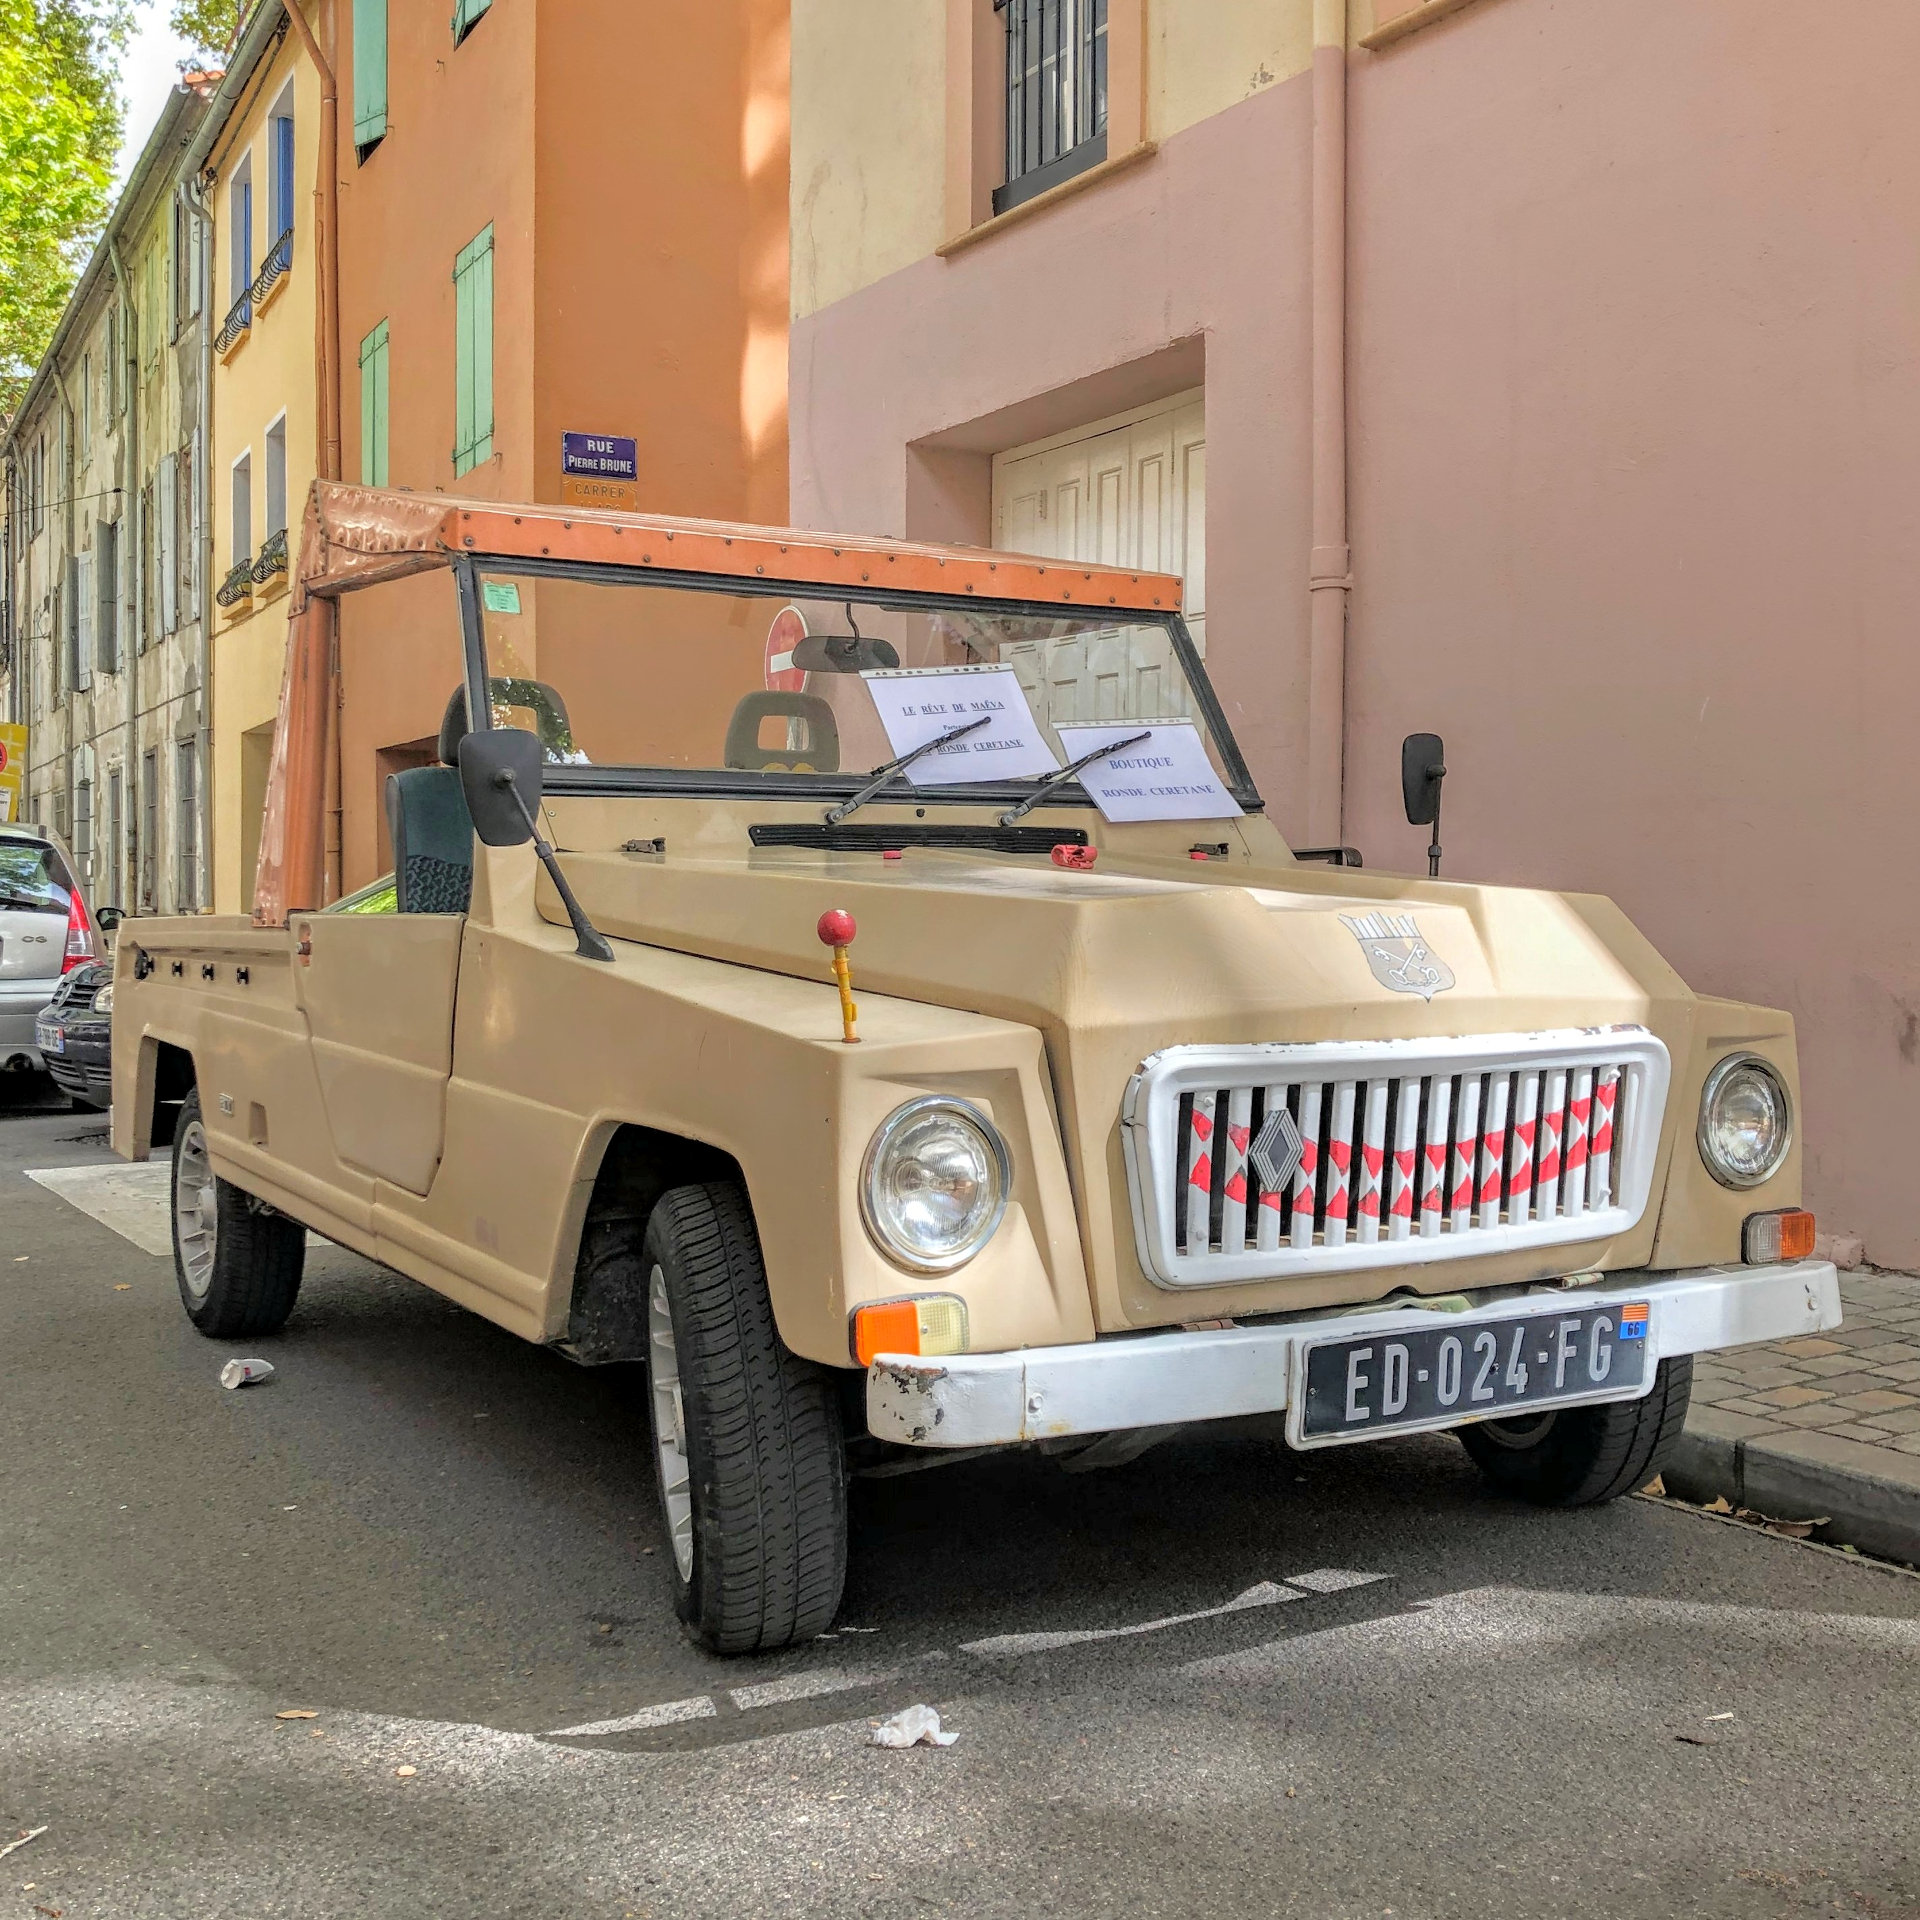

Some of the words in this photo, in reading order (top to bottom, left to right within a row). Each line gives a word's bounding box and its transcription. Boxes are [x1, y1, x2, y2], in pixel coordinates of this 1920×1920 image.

[587, 439, 614, 454] RUE
[568, 454, 599, 470] PIERRE
[600, 457, 632, 473] BRUNE
[575, 483, 625, 499] CARRER
[902, 706, 917, 716] LE
[952, 703, 967, 712] DE
[937, 743, 970, 754] RONDE
[1109, 757, 1173, 770] BOUTIQUE
[1101, 787, 1146, 798] RONDE
[1150, 784, 1215, 796] CERETANE
[1627, 1322, 1640, 1336] 66
